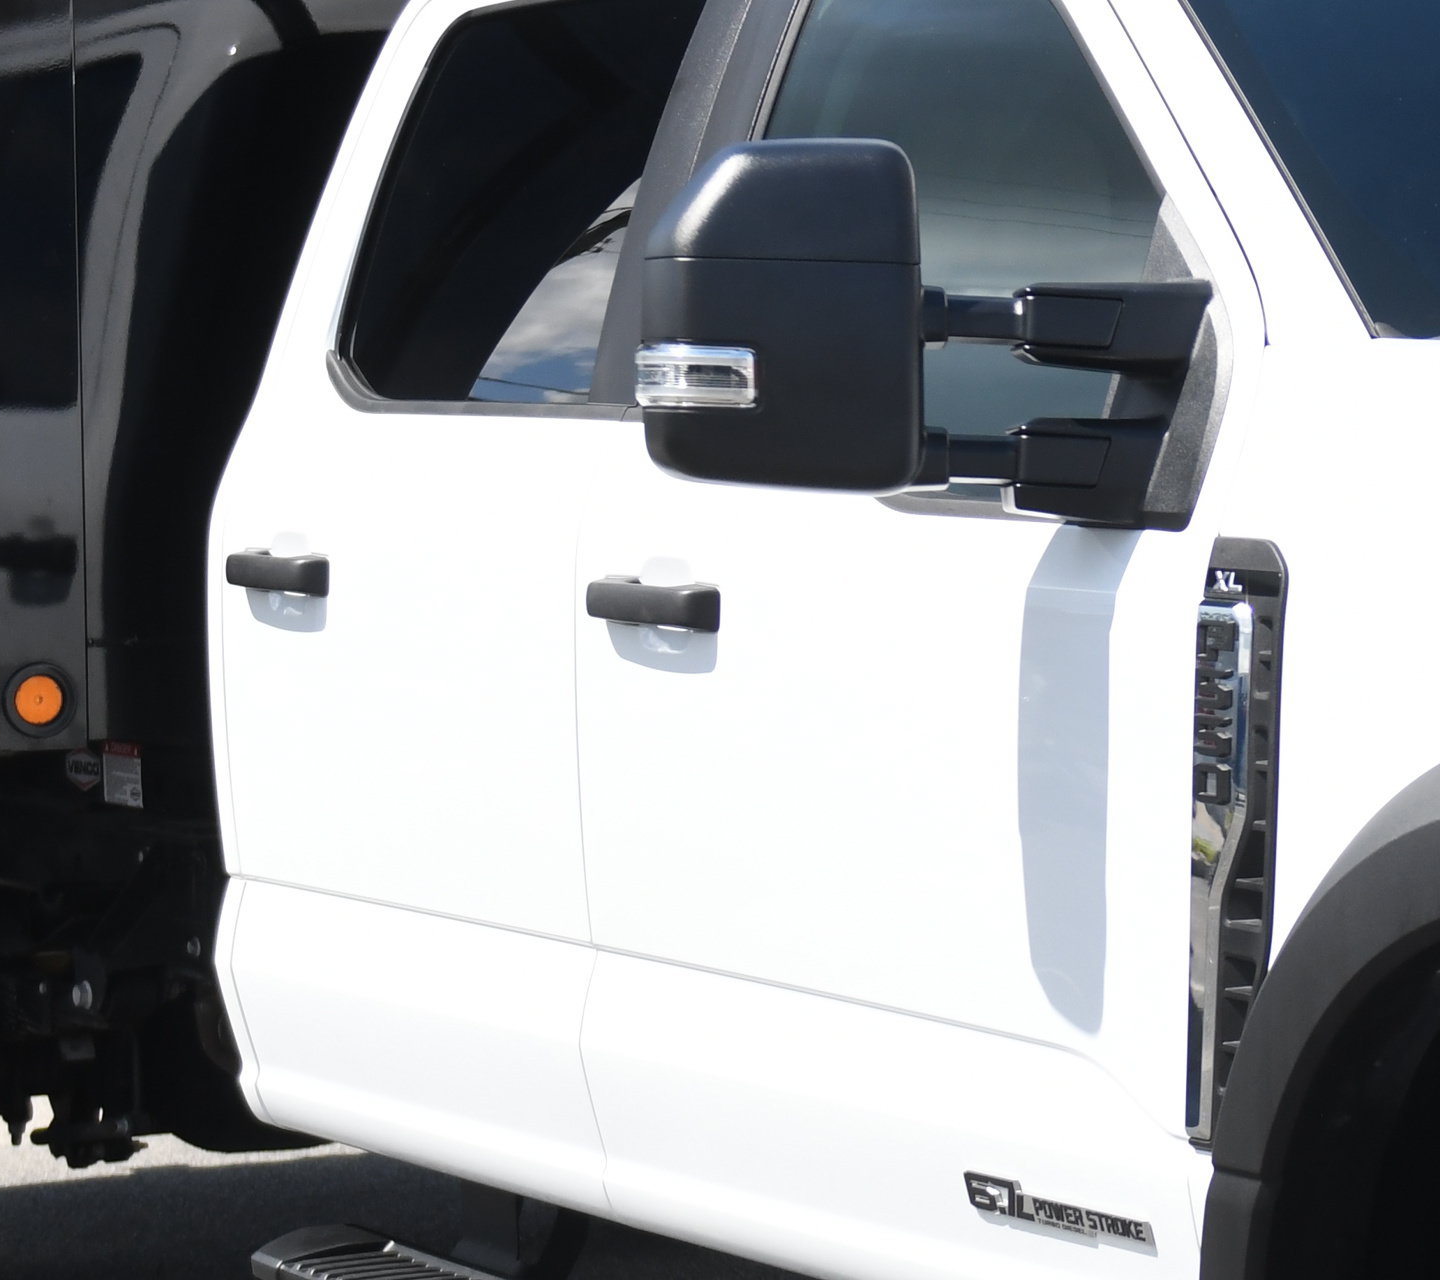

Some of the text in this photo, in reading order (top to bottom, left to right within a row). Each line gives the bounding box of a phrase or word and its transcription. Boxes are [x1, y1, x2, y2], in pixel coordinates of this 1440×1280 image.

[1212, 570, 1243, 592] XL
[67, 759, 100, 775] VENCO
[963, 1170, 1147, 1243] 6.7L POWER STROKE
